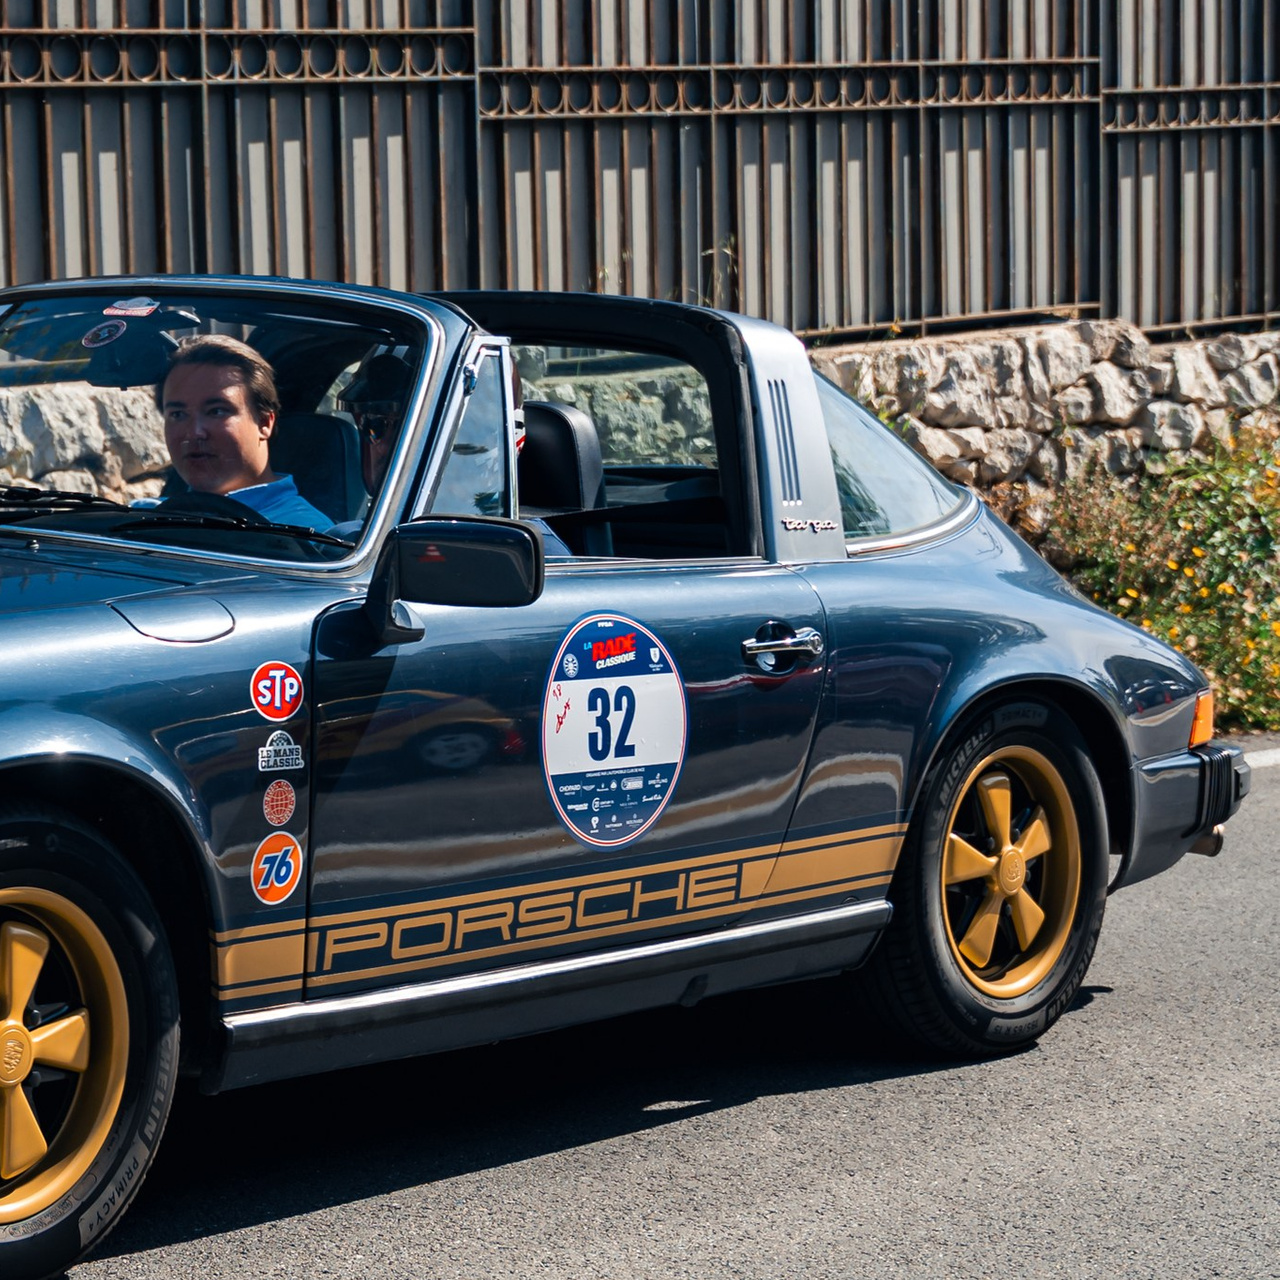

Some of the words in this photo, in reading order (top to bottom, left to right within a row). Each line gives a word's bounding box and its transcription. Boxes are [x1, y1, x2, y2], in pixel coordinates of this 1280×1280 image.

[781, 517, 838, 534] targa
[583, 641, 592, 651] LA
[592, 632, 637, 661] RADE
[596, 651, 636, 670] CLASSIQUE
[257, 669, 300, 710] STP
[587, 685, 636, 762] 32
[260, 749, 272, 759] LE
[273, 747, 301, 758] MANS
[939, 719, 993, 806] MICHELIN
[257, 846, 295, 889] 76
[323, 864, 738, 971] PORSCHE
[1046, 935, 1098, 1022] MICHELIN
[139, 991, 177, 1146] MICHELIN
[94, 1155, 140, 1227] PRIMACY
